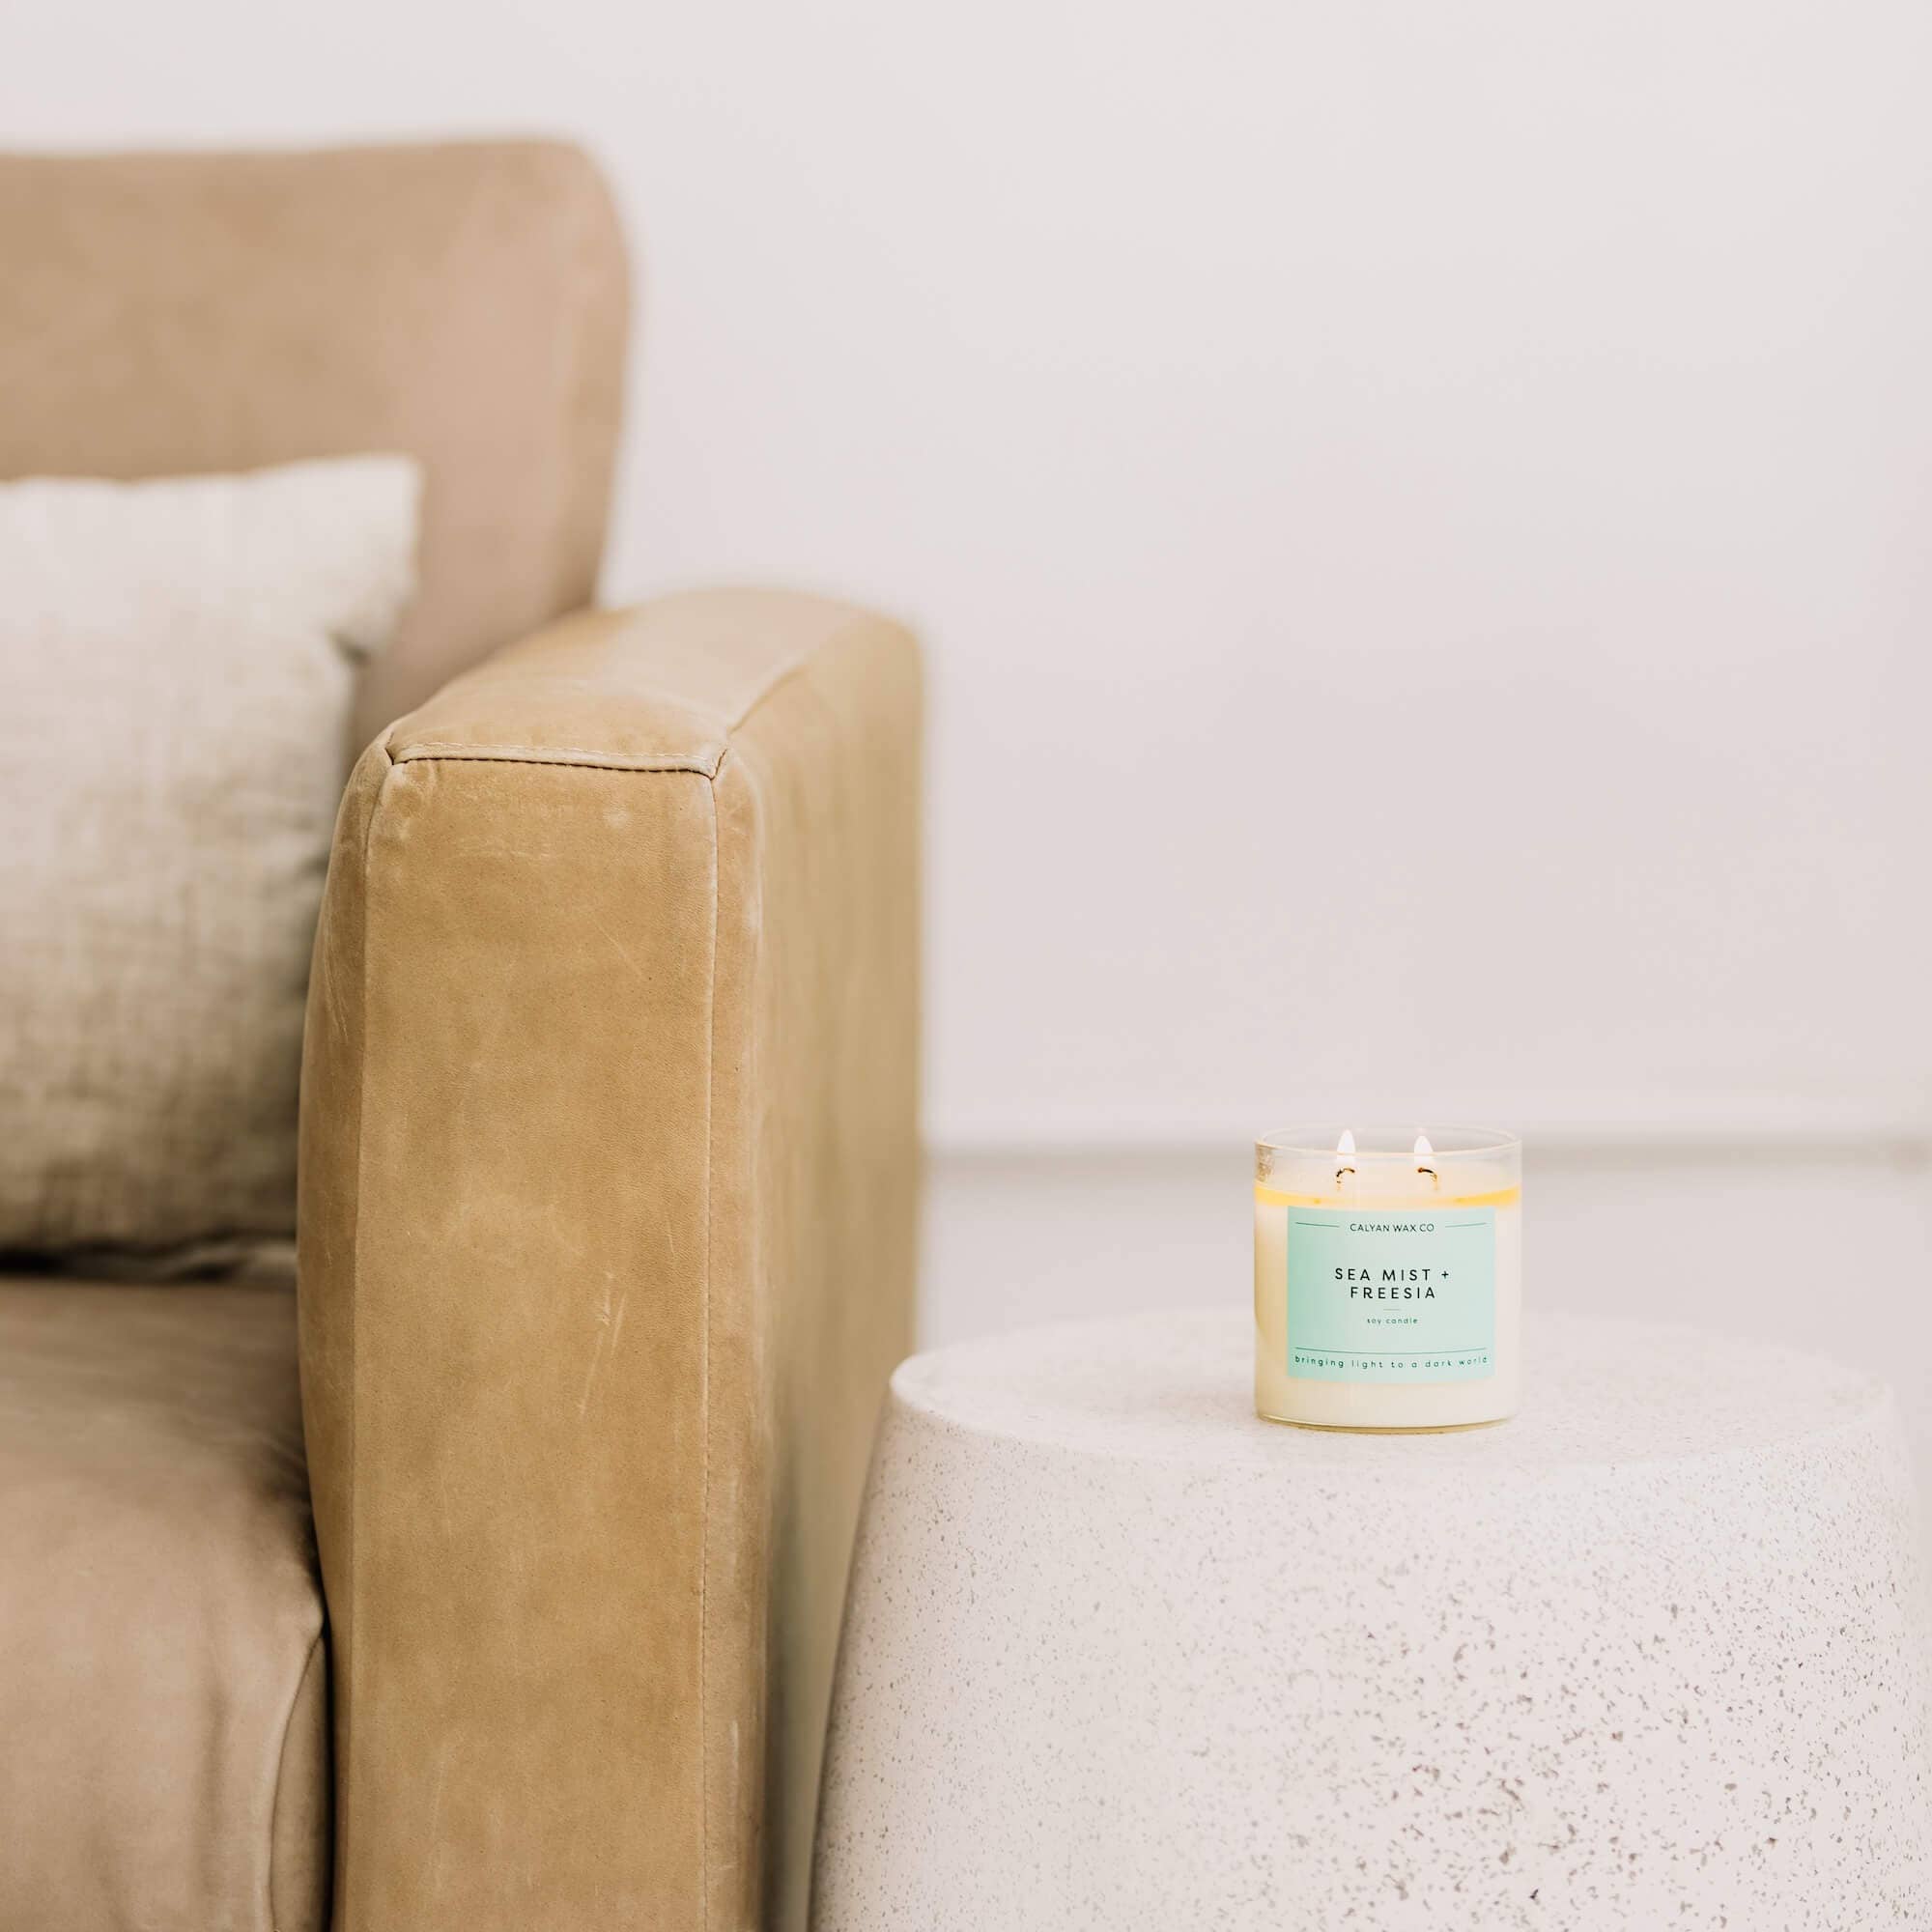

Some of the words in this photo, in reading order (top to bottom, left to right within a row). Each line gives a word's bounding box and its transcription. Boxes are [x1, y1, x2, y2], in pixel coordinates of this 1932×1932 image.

[1350, 1223, 1390, 1233] CALYAN
[1393, 1224, 1416, 1233] WAX
[1419, 1223, 1435, 1233] CO
[1335, 1267, 1371, 1281] SEA
[1382, 1268, 1431, 1281] MIST
[1441, 1270, 1449, 1279] +
[1350, 1287, 1435, 1299] FREESIA
[1294, 1355, 1345, 1368] bringing
[1351, 1359, 1383, 1369] light
[1425, 1359, 1452, 1368] dark
[1459, 1355, 1488, 1366] world
